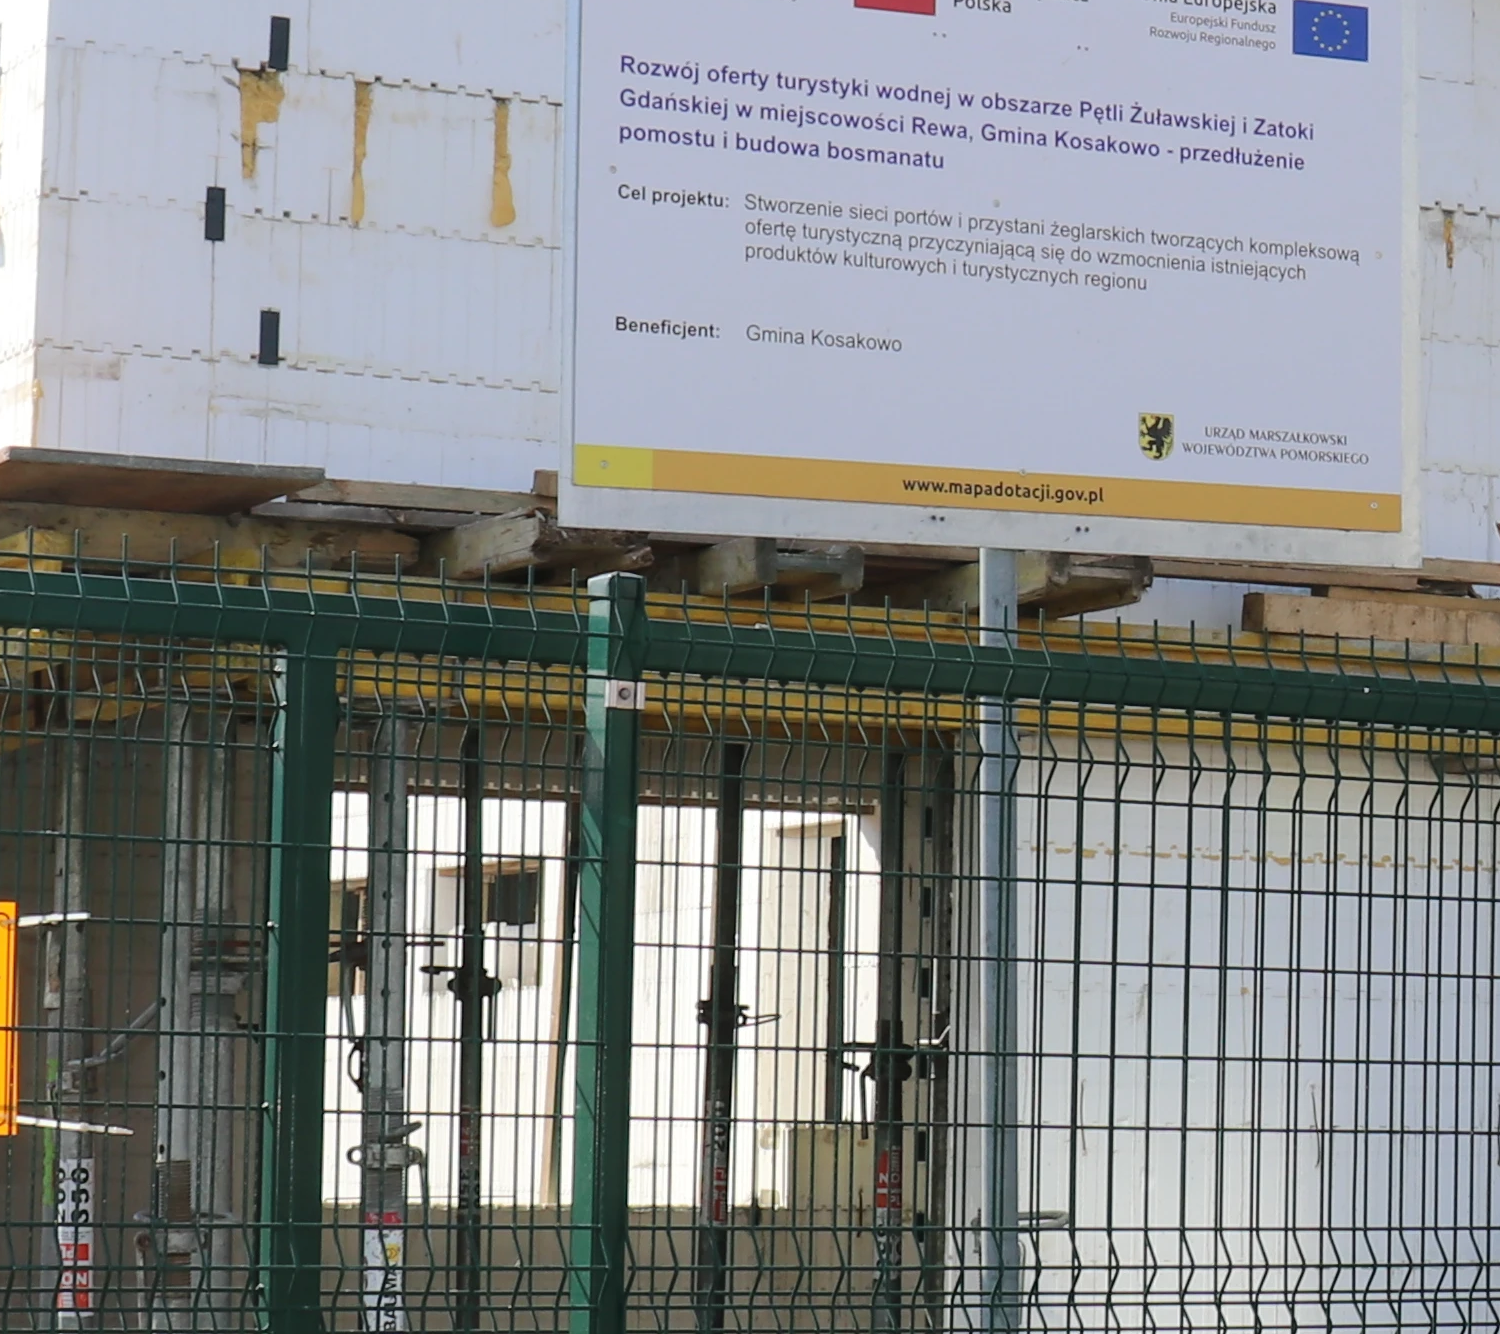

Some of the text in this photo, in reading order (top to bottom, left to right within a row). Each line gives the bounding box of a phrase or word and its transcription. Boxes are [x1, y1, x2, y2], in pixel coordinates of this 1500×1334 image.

[1169, 11, 1277, 34] Europejski Fundusz
[1149, 25, 1277, 52] Rozwoju Regionalnego
[620, 54, 1314, 141] Rozwój oferty turystyki wodnej w obszarze Pętli Żuławskiej i Zatoki
[619, 87, 729, 122] Gdańskiej
[734, 103, 754, 119] w
[759, 103, 905, 134] miejscowości
[911, 115, 974, 144] Rewa,
[980, 122, 1048, 148] Gmina
[1054, 129, 1161, 158] Kosakowo
[1179, 146, 1306, 171] przedłużenie
[618, 125, 945, 170] pomostu i budowa bosmanatu
[617, 183, 730, 209] Cel projektu:
[743, 192, 1361, 267] Stworzenie sieci portów i przystani żeglarskich tworzących kompleksową
[744, 217, 1307, 284] ofertę turystyczną przyczyniającą się do wzmocnienia istniejących
[744, 243, 1148, 293] produktów kulturowych i turystycznych regionu
[614, 315, 721, 341] Beneficjent:
[745, 323, 903, 353] Gmina Kosakowo
[1204, 425, 1348, 447] URZĄD MARSZAŁKOWSKI
[1181, 441, 1370, 466] WOJEWÓDZTWA POMORSKIEGO
[901, 479, 1105, 506] www.mapadotacji.gov.pl
